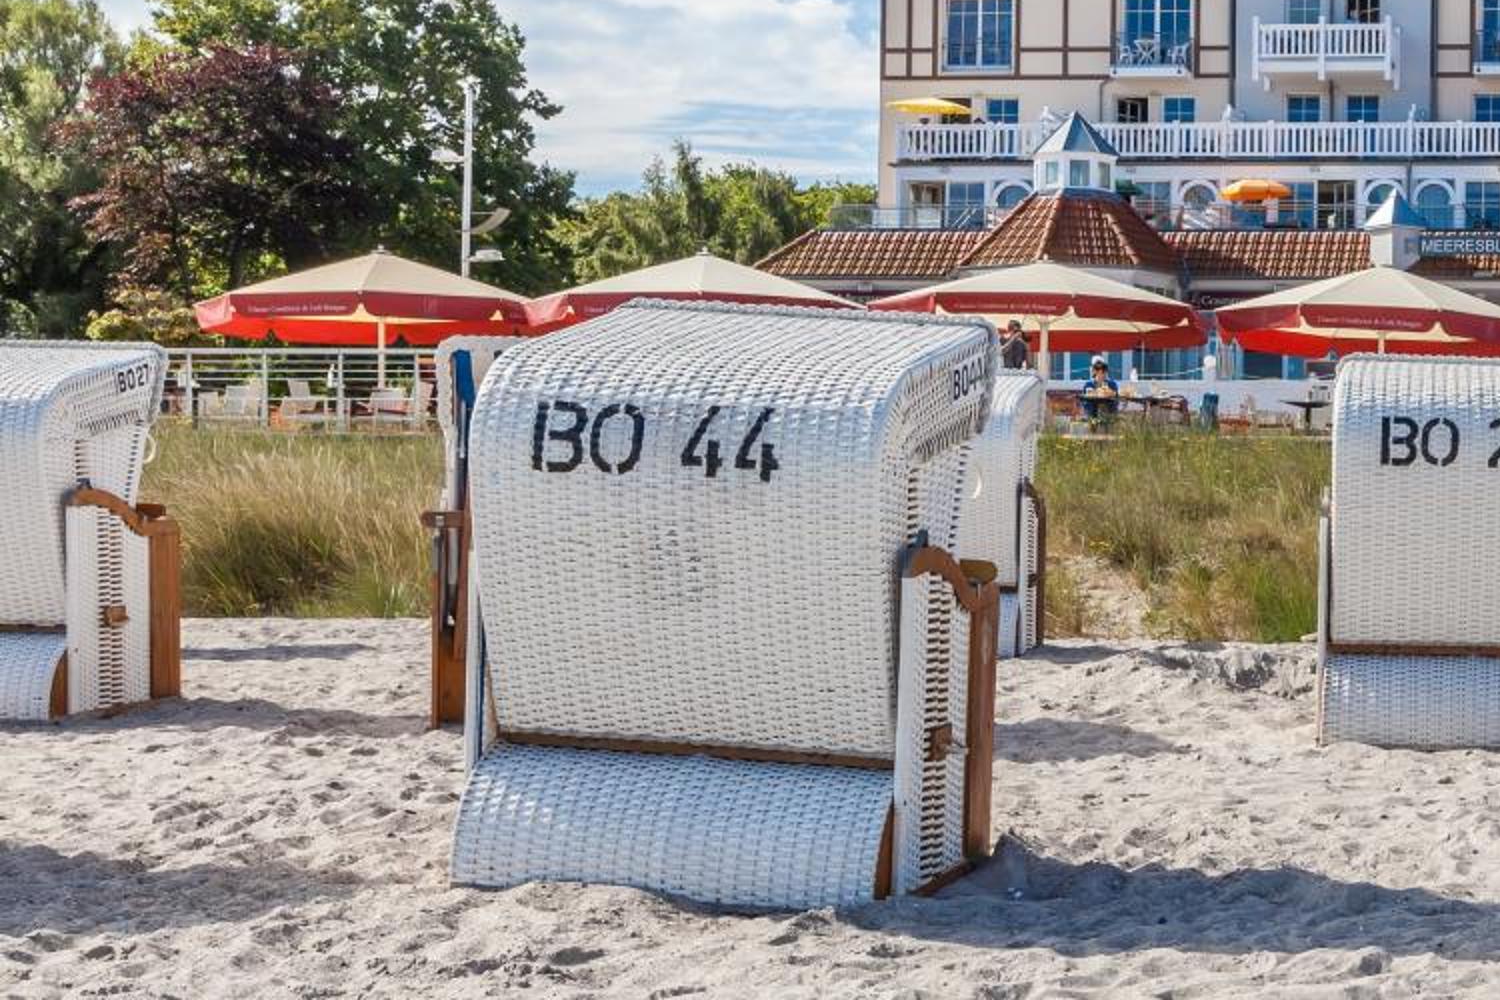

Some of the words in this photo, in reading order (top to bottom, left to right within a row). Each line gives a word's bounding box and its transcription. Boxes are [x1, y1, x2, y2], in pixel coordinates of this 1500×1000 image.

[532, 400, 645, 474] BO
[681, 405, 779, 482] 44
[1380, 416, 1460, 467] BO
